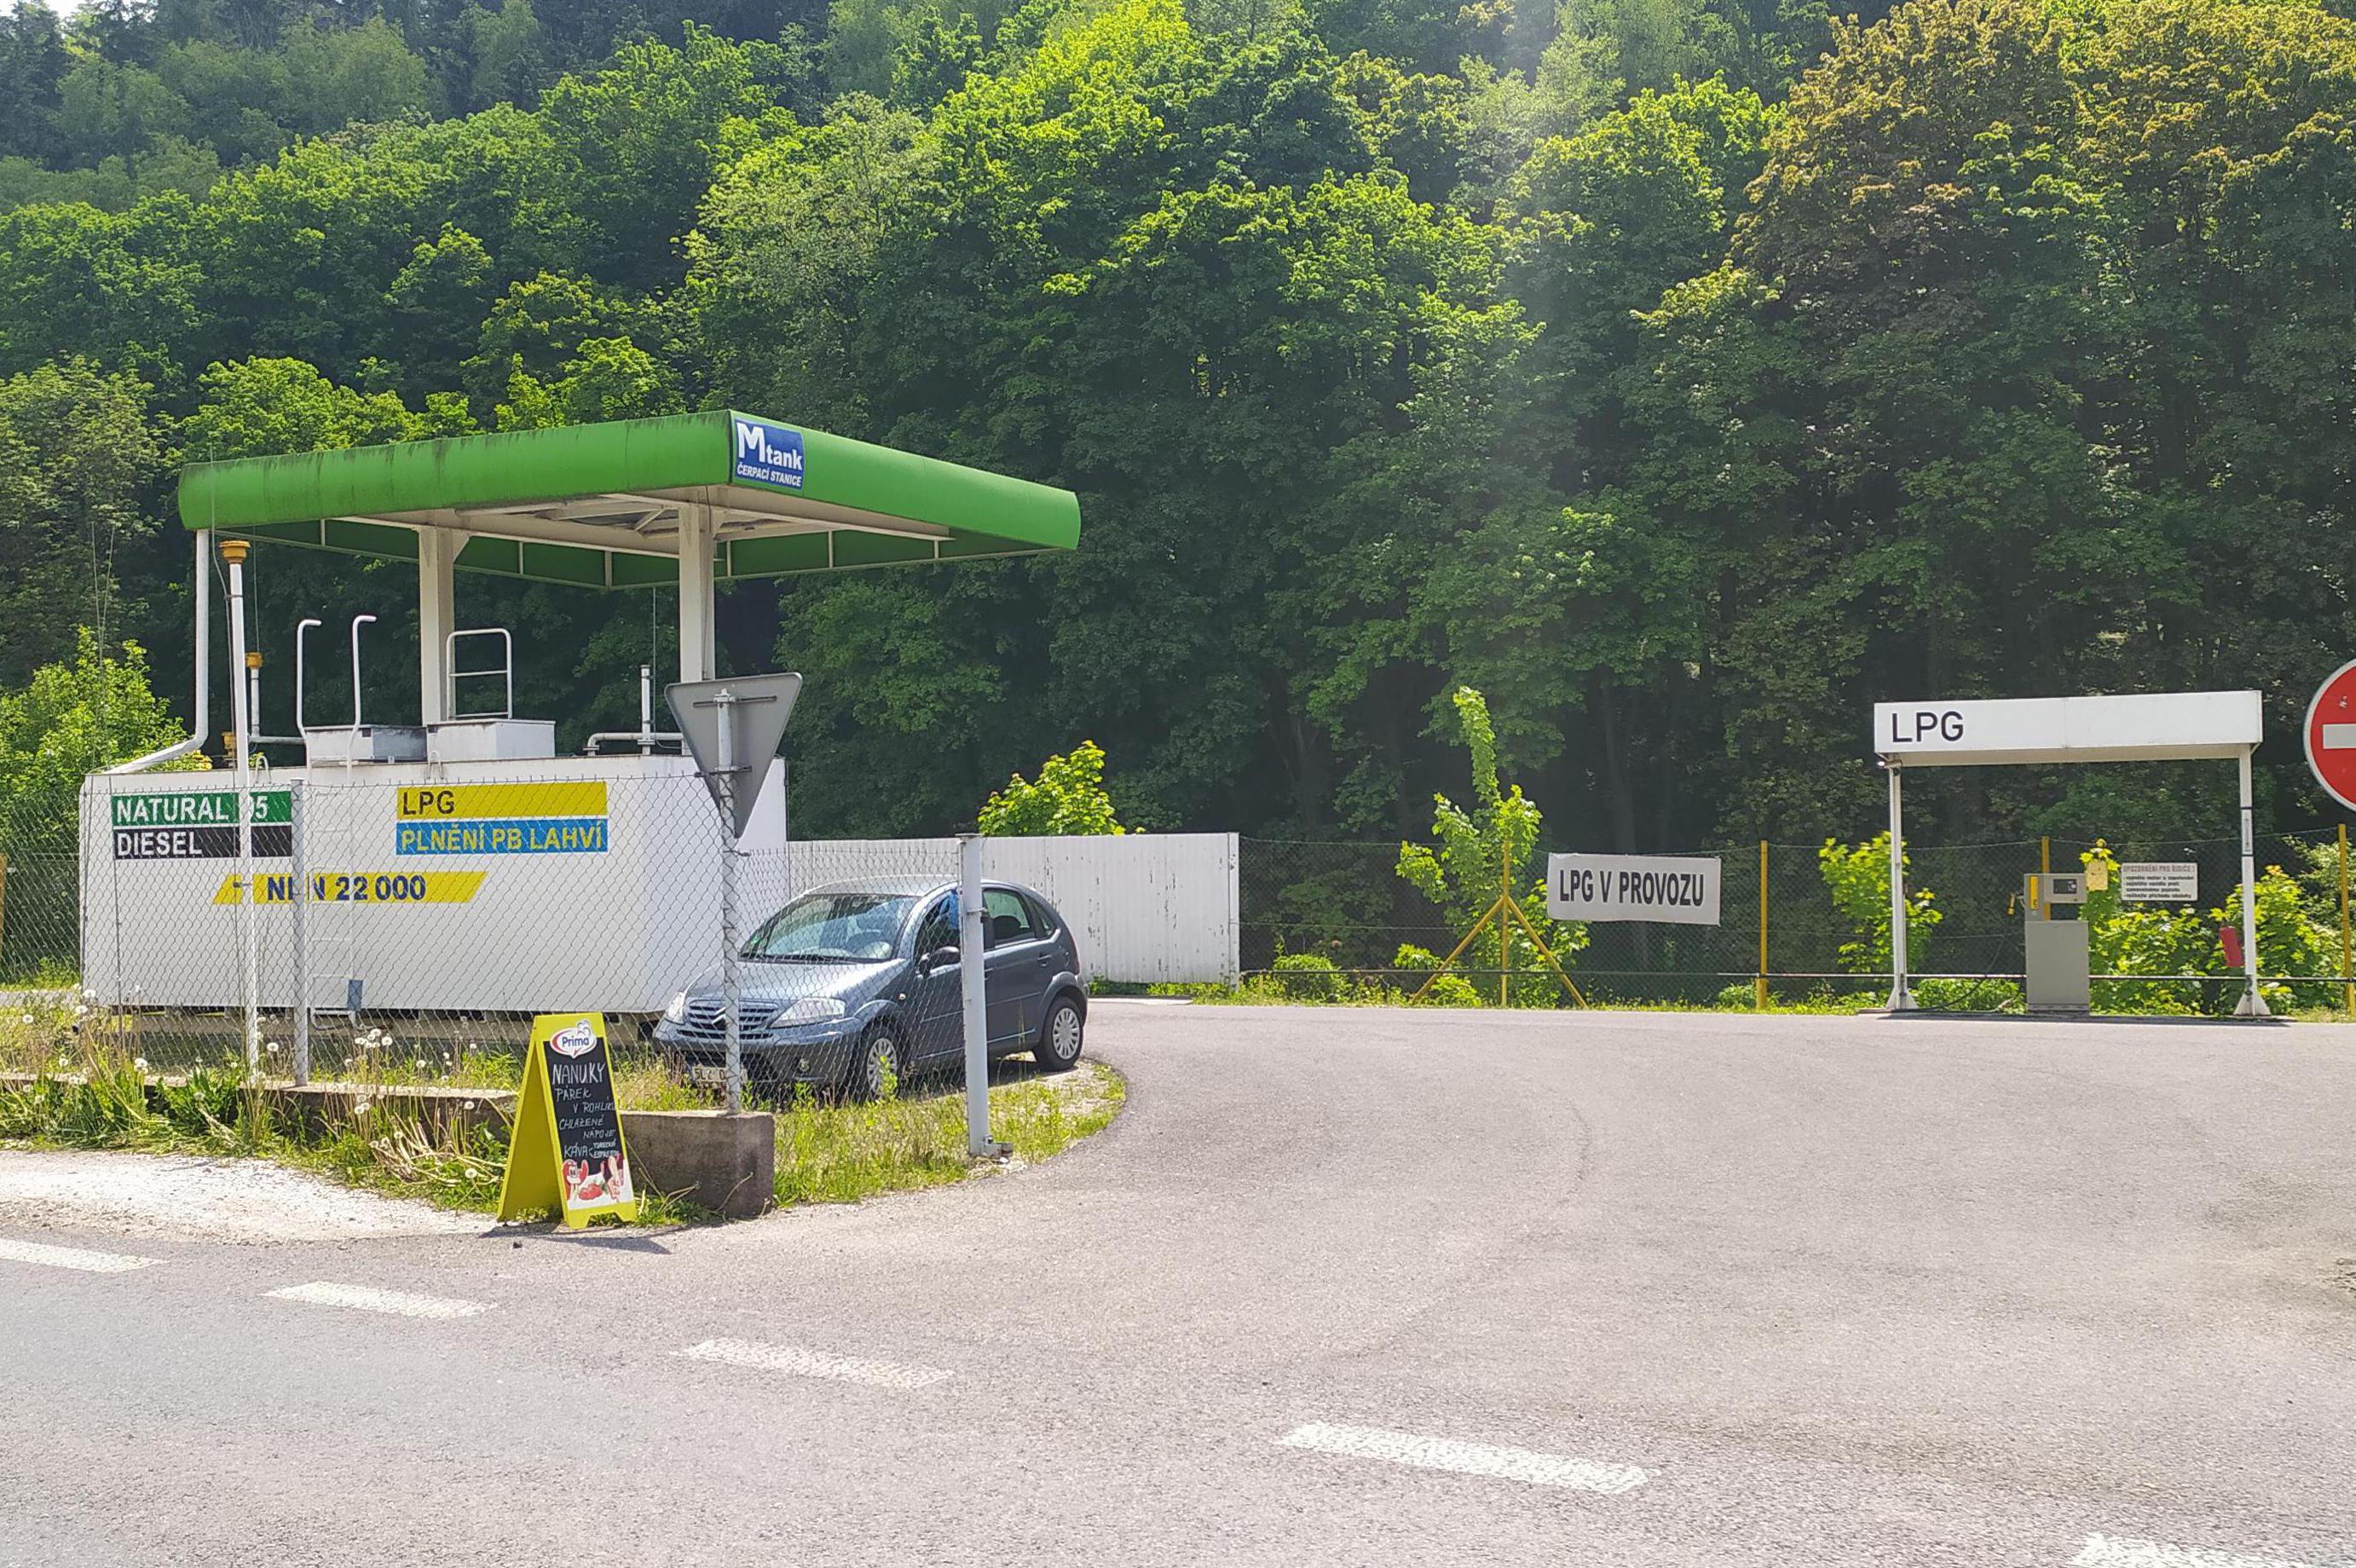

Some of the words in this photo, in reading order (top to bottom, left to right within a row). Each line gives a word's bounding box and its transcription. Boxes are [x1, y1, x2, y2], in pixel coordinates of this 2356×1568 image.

[736, 422, 803, 470] Mtank
[736, 461, 770, 481] ČERPACÍ
[771, 470, 802, 487] STANICE
[1891, 711, 1964, 743] LPG
[117, 794, 229, 824] NATURAL
[402, 790, 455, 816] LPG
[117, 830, 203, 856] DIESEL
[401, 823, 485, 851] PLNĚNÍ
[492, 827, 523, 850] PB
[530, 821, 603, 850] LAHVÍ
[268, 876, 326, 902] NN
[335, 876, 368, 902] 22
[374, 875, 426, 901] 000
[1560, 869, 1594, 902] LPG
[1599, 870, 1613, 903] V
[1619, 871, 1704, 907] PROVOZU
[562, 1035, 590, 1048] Prima
[552, 1062, 606, 1085] NANUKY
[555, 1085, 592, 1102] PÁREK
[583, 1127, 616, 1139] NÁPOJE
[563, 1142, 588, 1159] KÁVA
